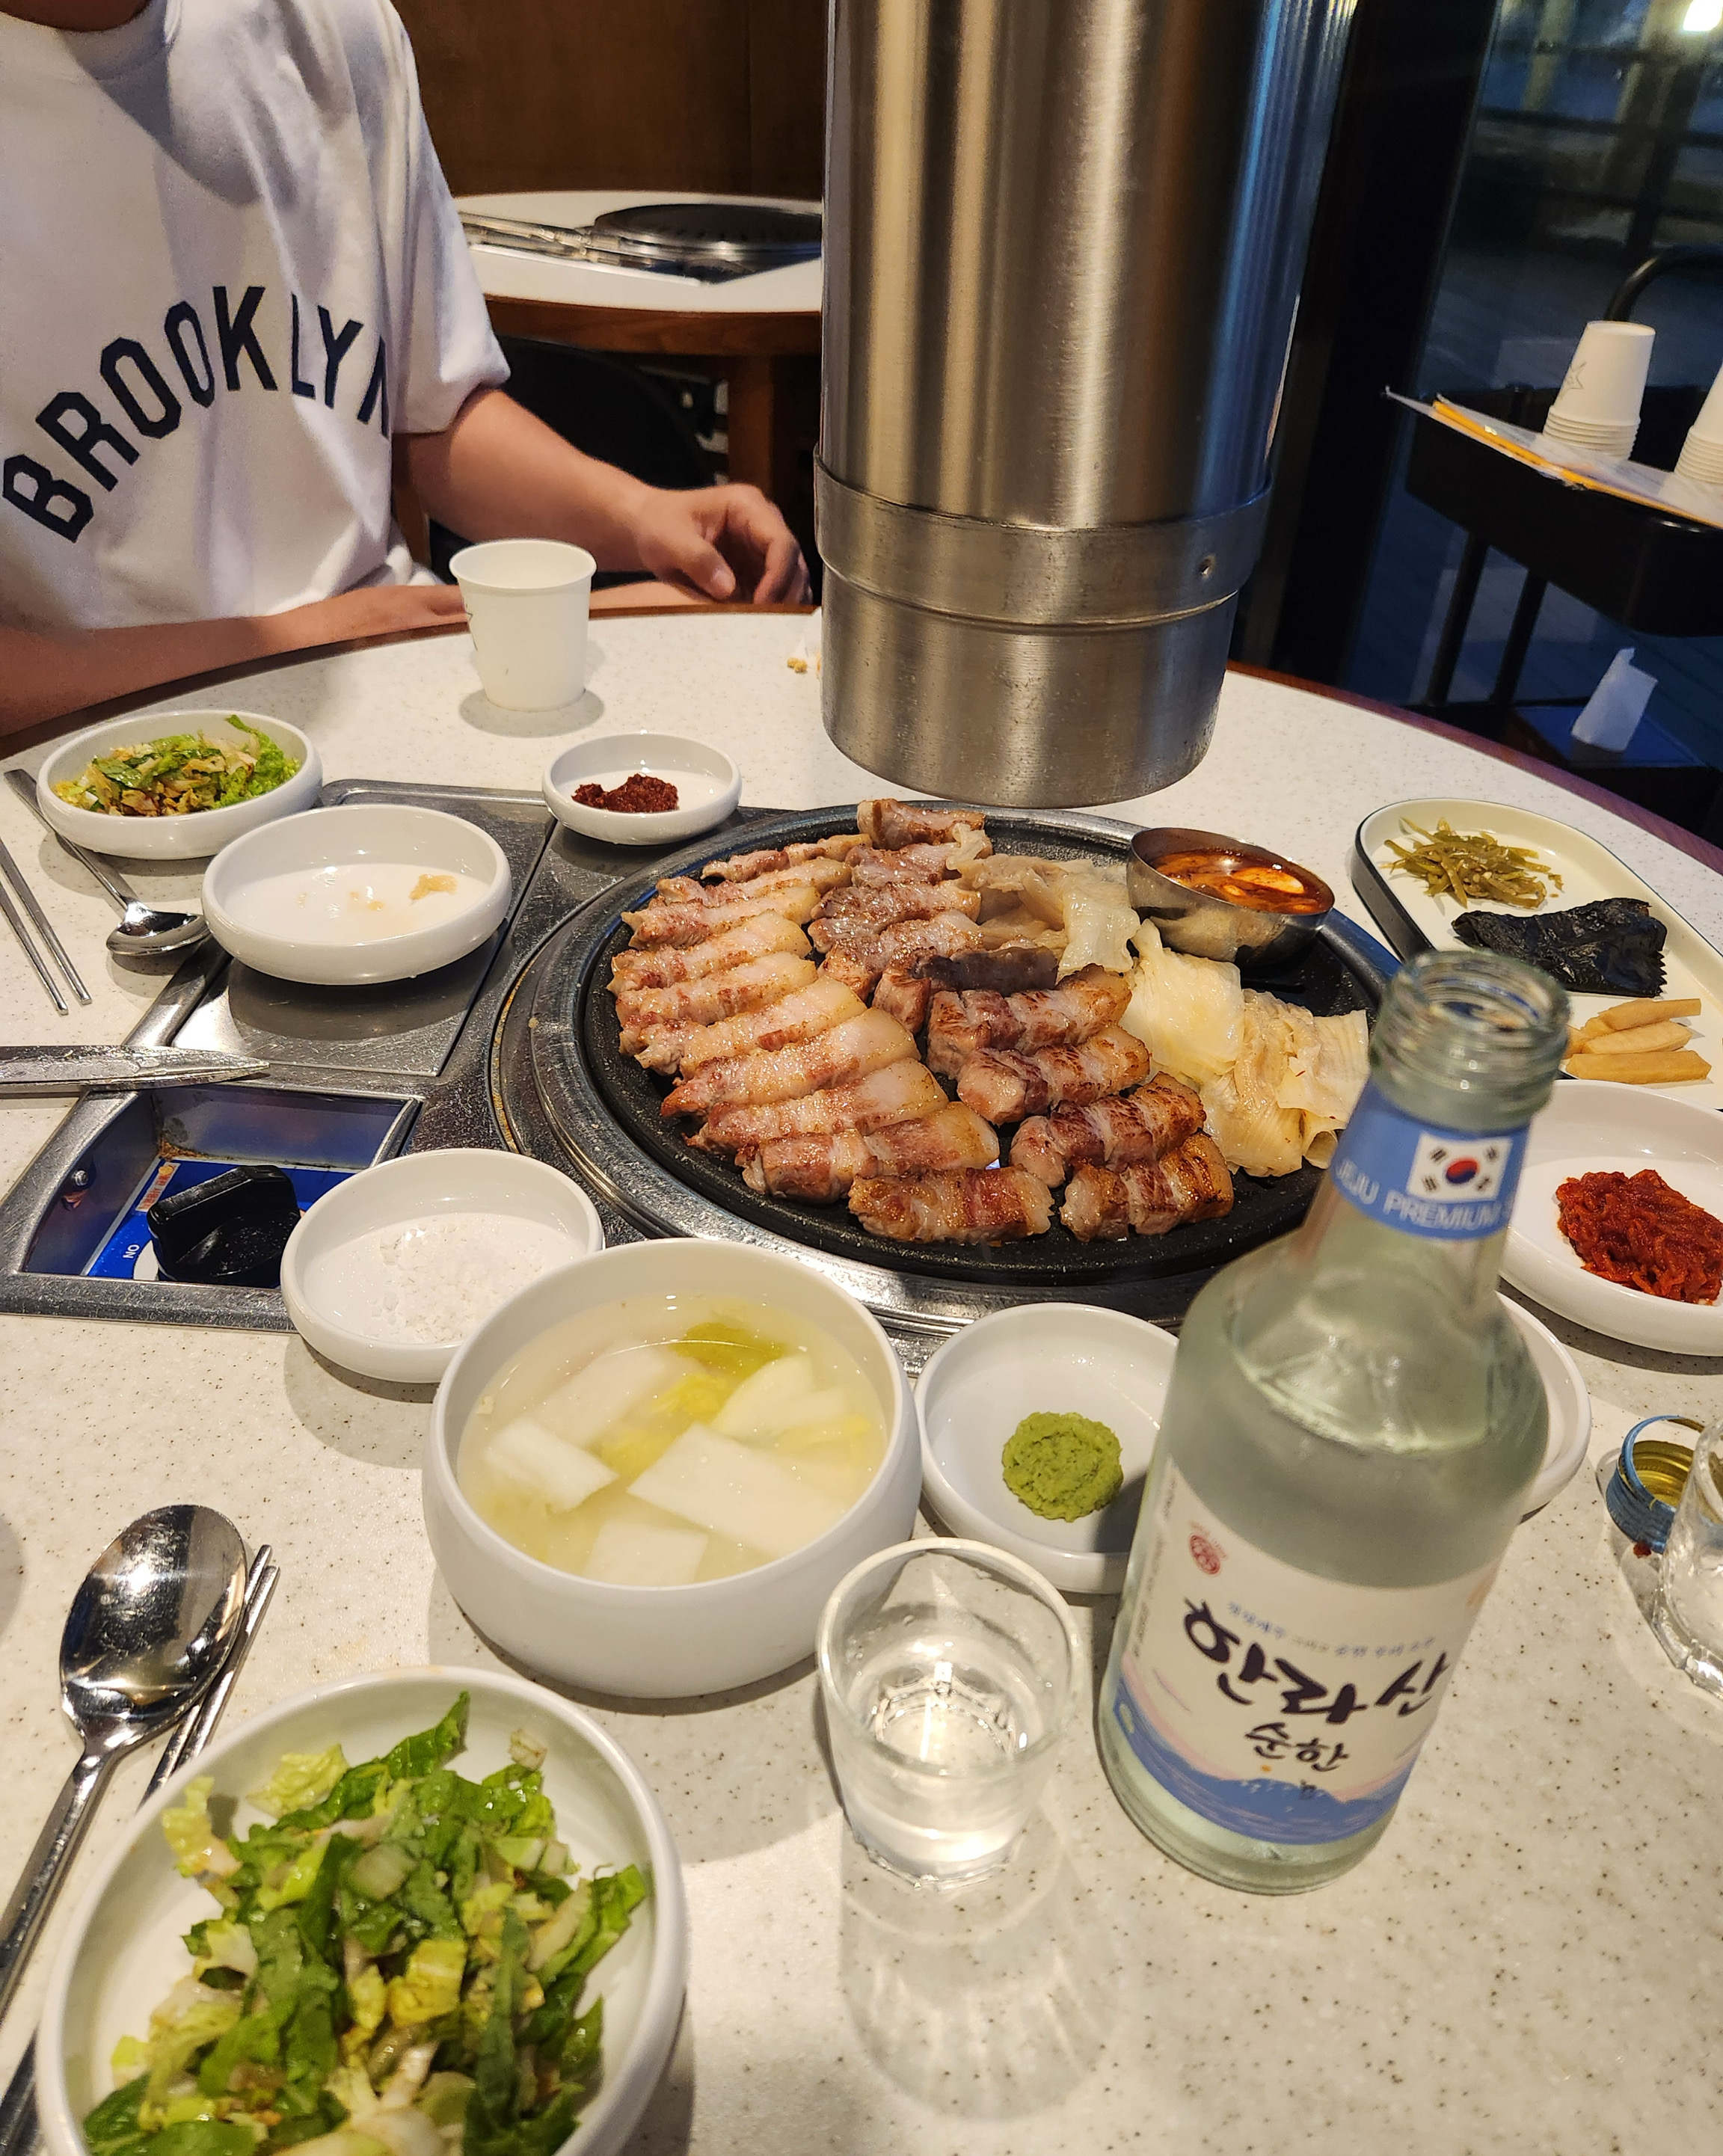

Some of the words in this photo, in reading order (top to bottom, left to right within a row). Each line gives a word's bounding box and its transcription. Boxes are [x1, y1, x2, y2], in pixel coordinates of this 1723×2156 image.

[1337, 1160, 1380, 1204] JEJU
[1383, 1191, 1502, 1230] PREMIUM
[1183, 1597, 1451, 1725] 한라산
[1244, 1722, 1350, 1772] 순한
